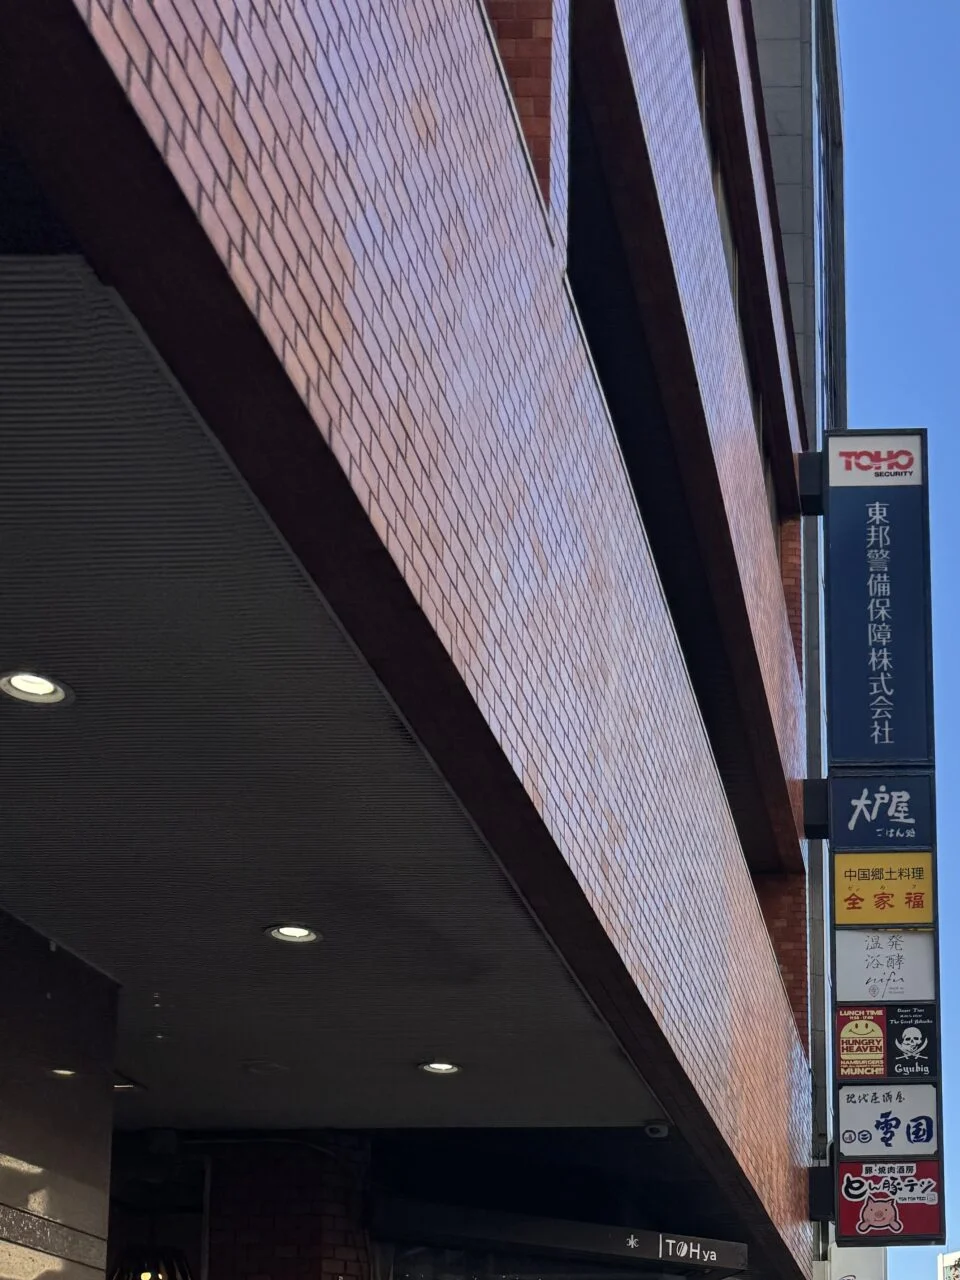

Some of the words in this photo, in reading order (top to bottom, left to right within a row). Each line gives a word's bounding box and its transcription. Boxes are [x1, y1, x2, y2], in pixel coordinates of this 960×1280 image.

[839, 450, 914, 471] TOHO
[866, 502, 894, 744] 東邦警備保障株式会社
[848, 785, 915, 830] 大戸屋
[844, 867, 924, 880] 中国郷土料理
[843, 892, 925, 910] 全家福
[865, 935, 885, 969] 温浴
[885, 934, 905, 970] 発酵
[894, 1062, 930, 1076] Gyubig
[874, 1110, 933, 1147] 雪国
